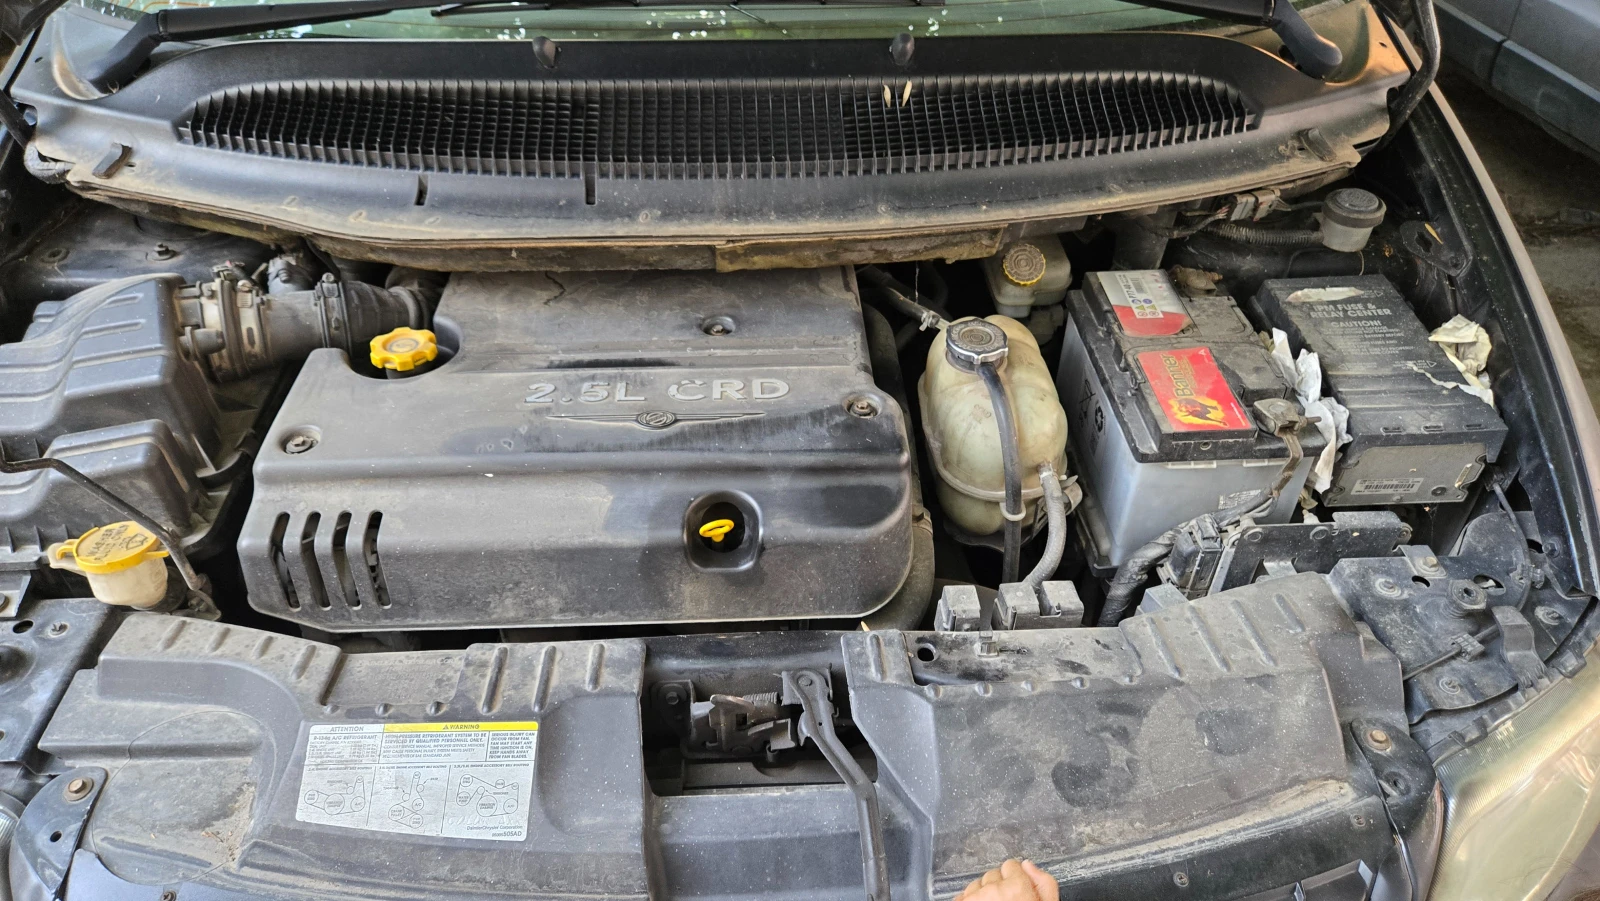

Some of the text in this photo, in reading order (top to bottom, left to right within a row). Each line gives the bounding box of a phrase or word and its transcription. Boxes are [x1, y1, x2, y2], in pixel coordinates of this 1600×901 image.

[1348, 308, 1392, 316] CENTER
[1160, 354, 1195, 398] Banner
[524, 378, 790, 404] 2.5L CRD
